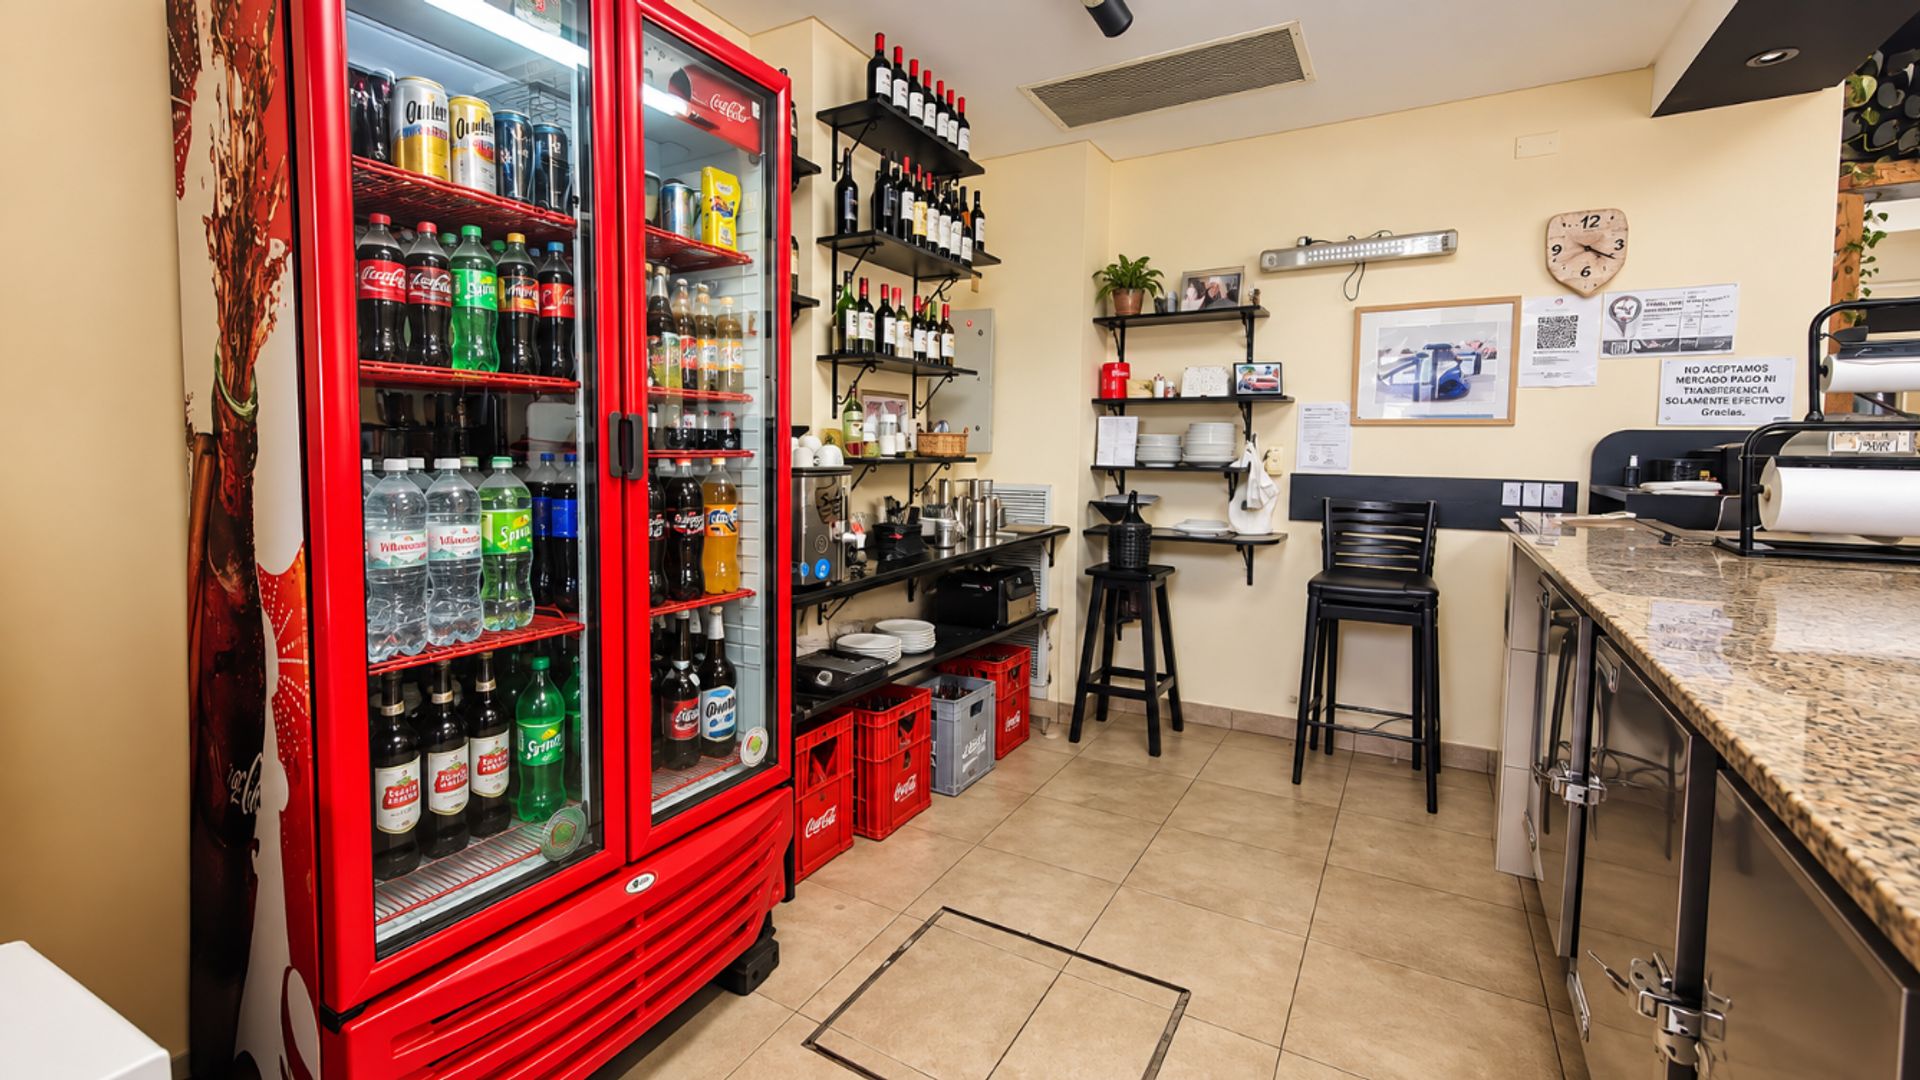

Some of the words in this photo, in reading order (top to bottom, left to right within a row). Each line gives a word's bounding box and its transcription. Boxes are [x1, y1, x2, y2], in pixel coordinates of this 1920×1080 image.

[1580, 215, 1601, 229] 12
[1614, 238, 1625, 250] 3
[1551, 244, 1562, 256] 9
[1580, 265, 1591, 277] 6
[1684, 366, 1700, 374] NO
[1702, 364, 1769, 374] ACEPTAMOS
[1676, 376, 1728, 384] MERCADO
[1730, 375, 1761, 383] PAGO
[1665, 396, 1729, 405] SOLAMENTE
[1731, 396, 1785, 405] EFECTIVO
[1701, 408, 1746, 416] Gracias.
